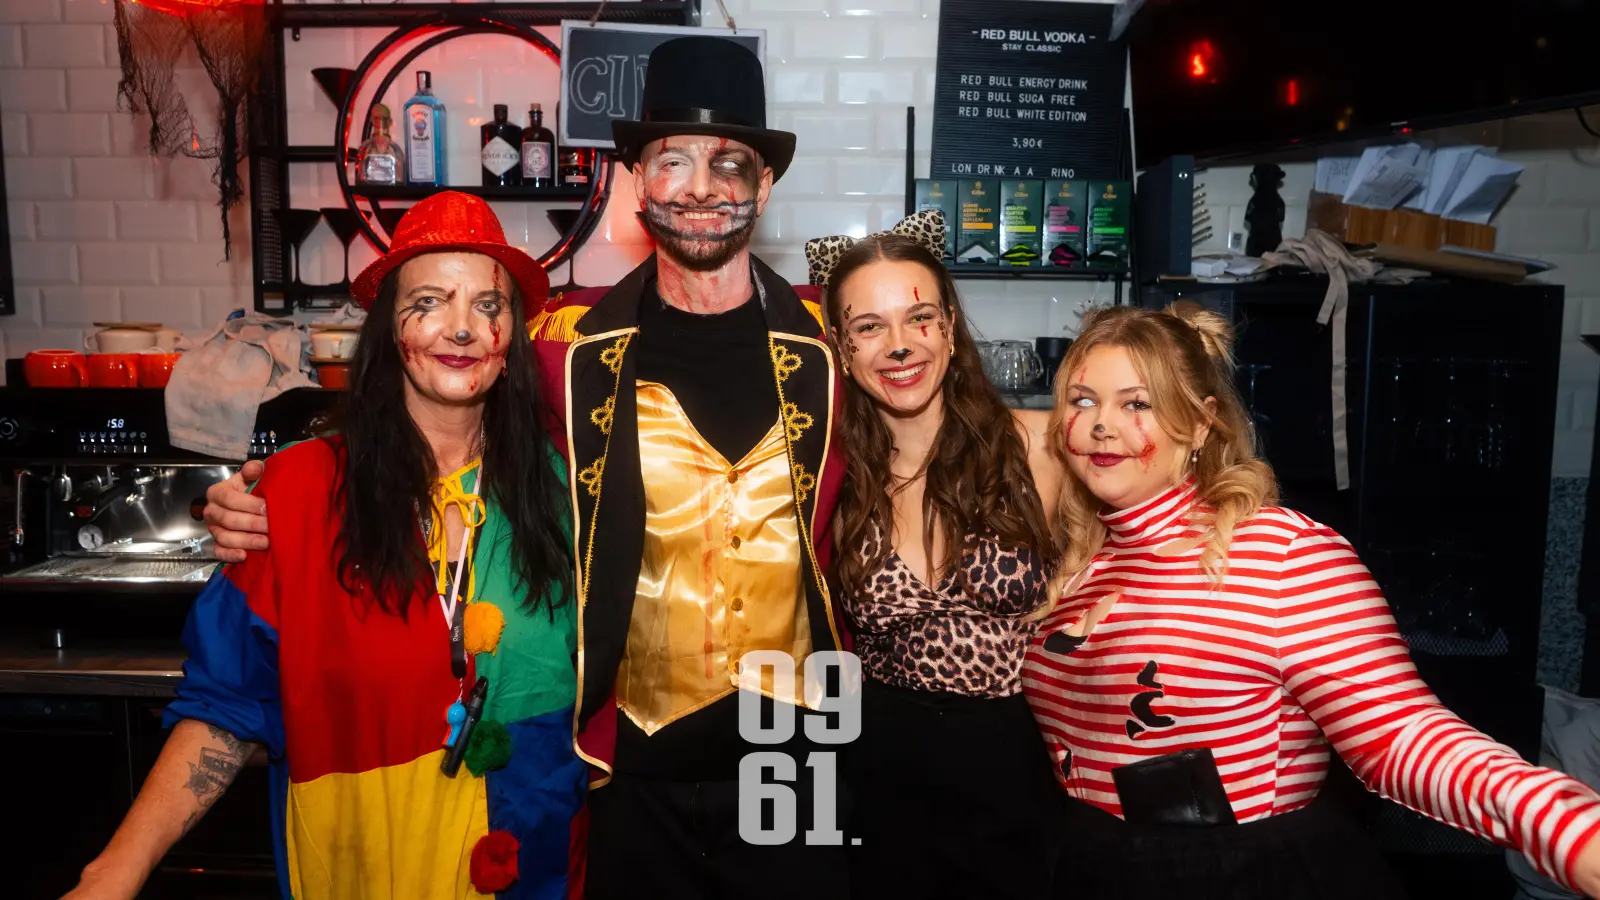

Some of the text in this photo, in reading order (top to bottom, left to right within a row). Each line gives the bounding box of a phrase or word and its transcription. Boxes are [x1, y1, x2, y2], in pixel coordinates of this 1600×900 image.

[981, 29, 1006, 40] RED
[1009, 30, 1040, 42] BULL
[1044, 32, 1086, 44] VODKA
[1002, 43, 1062, 53] STAY CLASSIC
[960, 75, 1088, 91] RED BULL ENERGY DRINK
[959, 91, 1076, 106] RED BULL SUGA FREE
[958, 106, 1087, 122] RED BULL WHITE EDITION
[952, 163, 972, 174] LON
[1051, 168, 1075, 179] RINO
